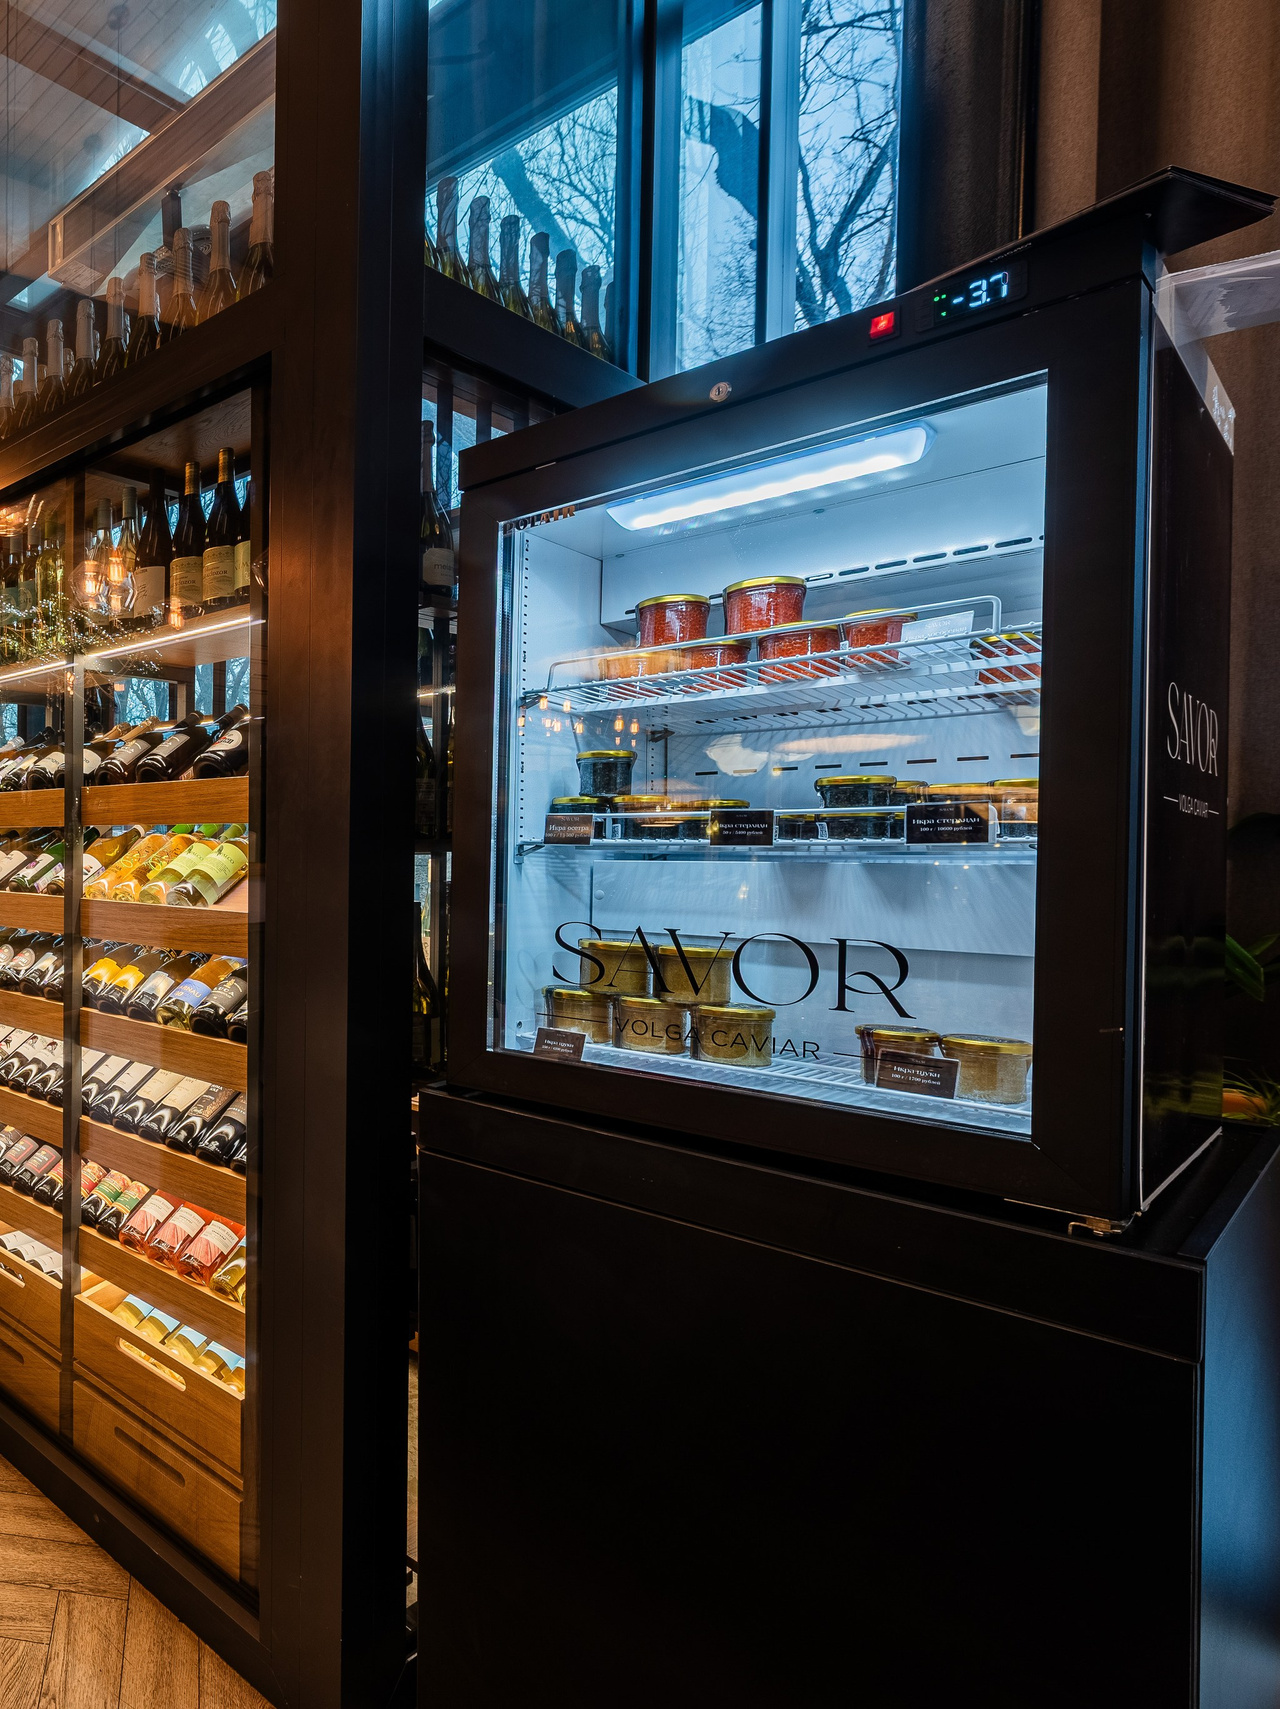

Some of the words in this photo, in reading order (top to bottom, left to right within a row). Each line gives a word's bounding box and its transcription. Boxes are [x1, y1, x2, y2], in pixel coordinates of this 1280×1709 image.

[502, 505, 576, 535] POLAIR
[1167, 681, 1219, 777] SAVOR
[1178, 793, 1194, 815] VOLGA
[549, 824, 567, 832] Икра
[551, 921, 918, 1020] SAVOR
[614, 1016, 701, 1043] VOLGA
[710, 1029, 821, 1060] CAVIAR
[893, 1066, 915, 1074] Икра
[917, 1070, 940, 1078] щуки
